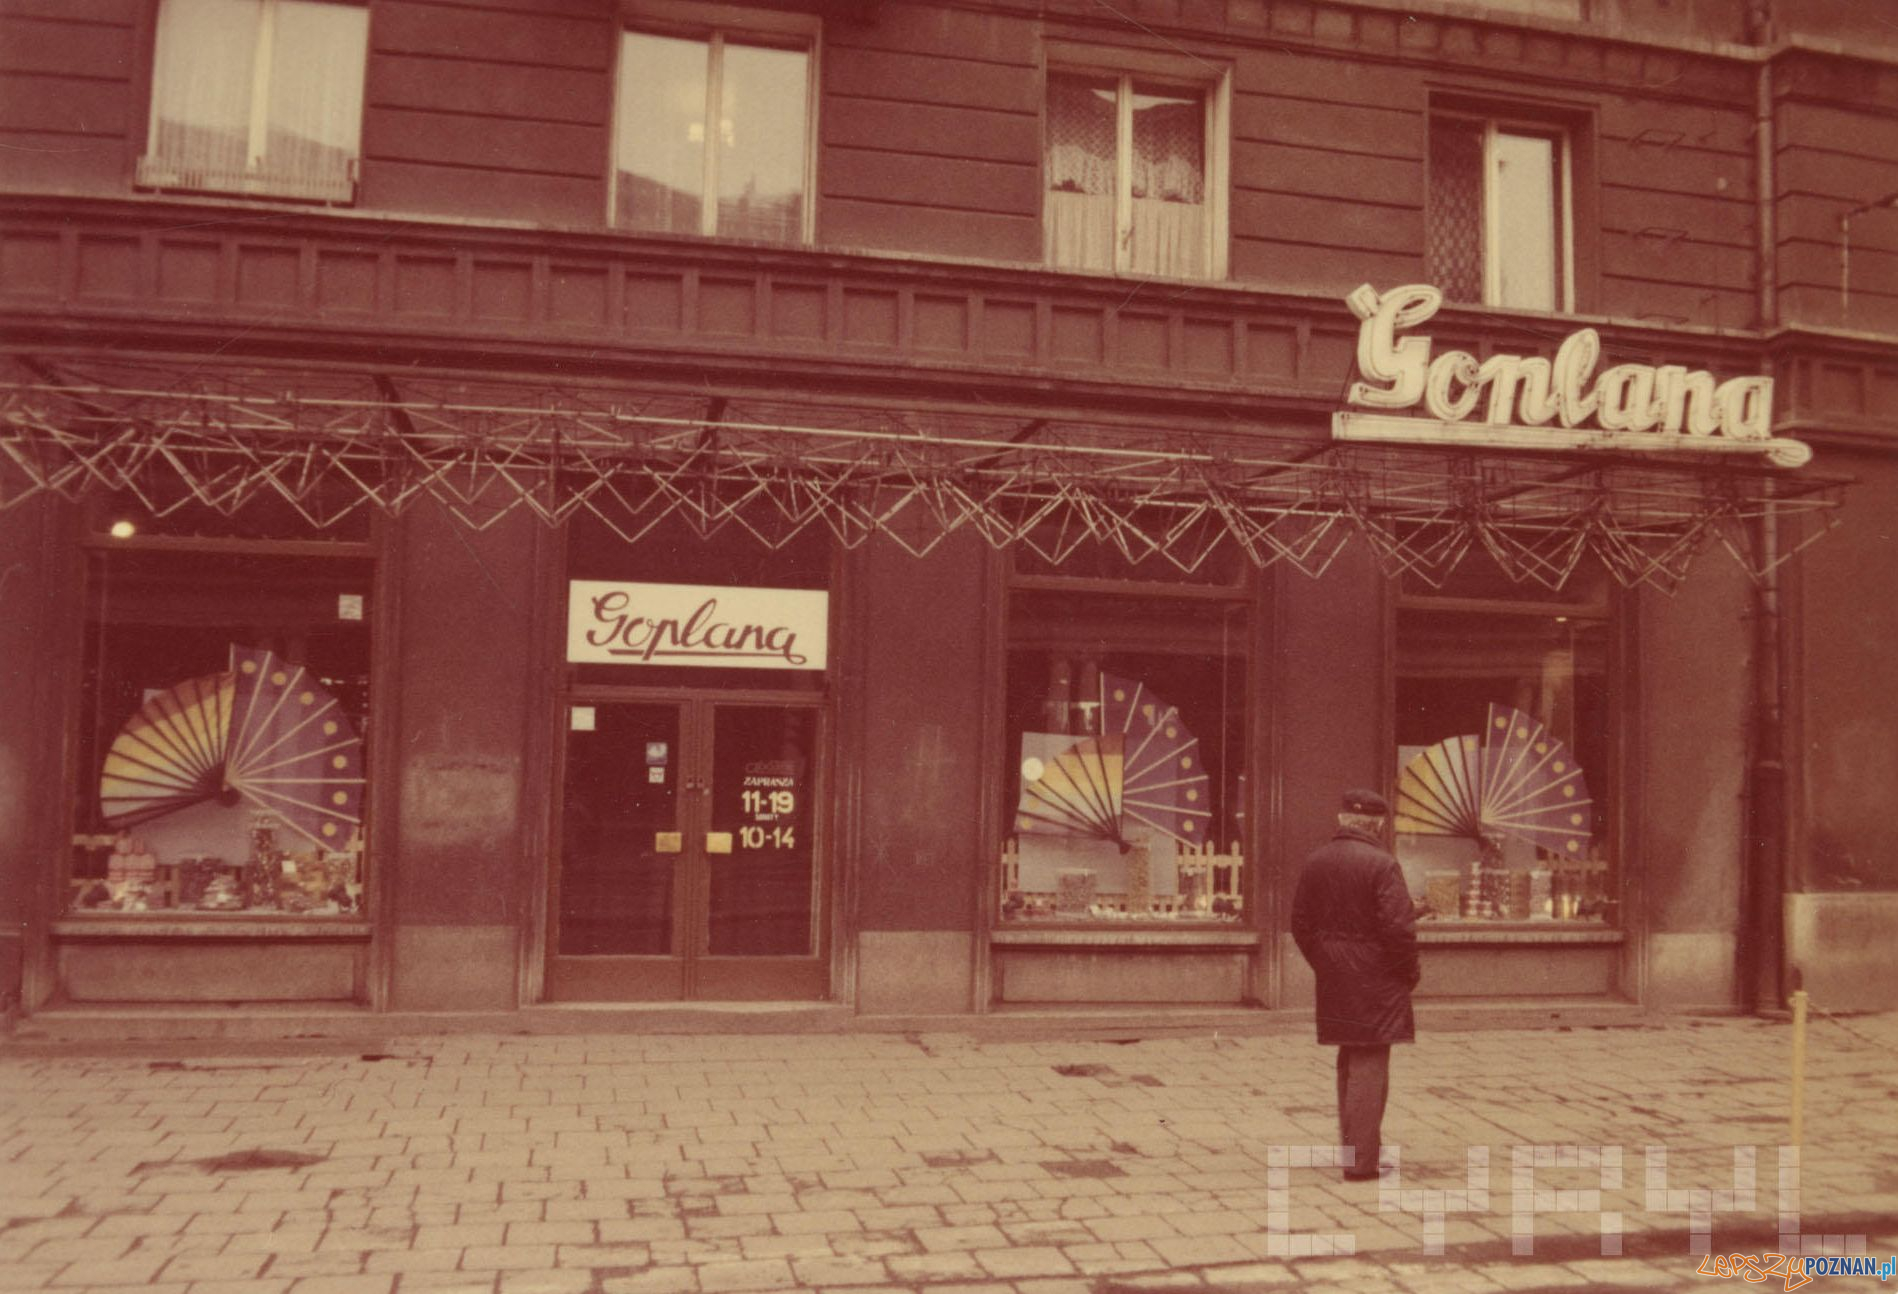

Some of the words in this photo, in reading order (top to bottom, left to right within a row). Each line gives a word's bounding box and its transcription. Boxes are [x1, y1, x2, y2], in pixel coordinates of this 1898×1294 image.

[586, 591, 808, 665] Goplana
[741, 790, 795, 814] 11-19
[739, 826, 795, 849] 10-14
